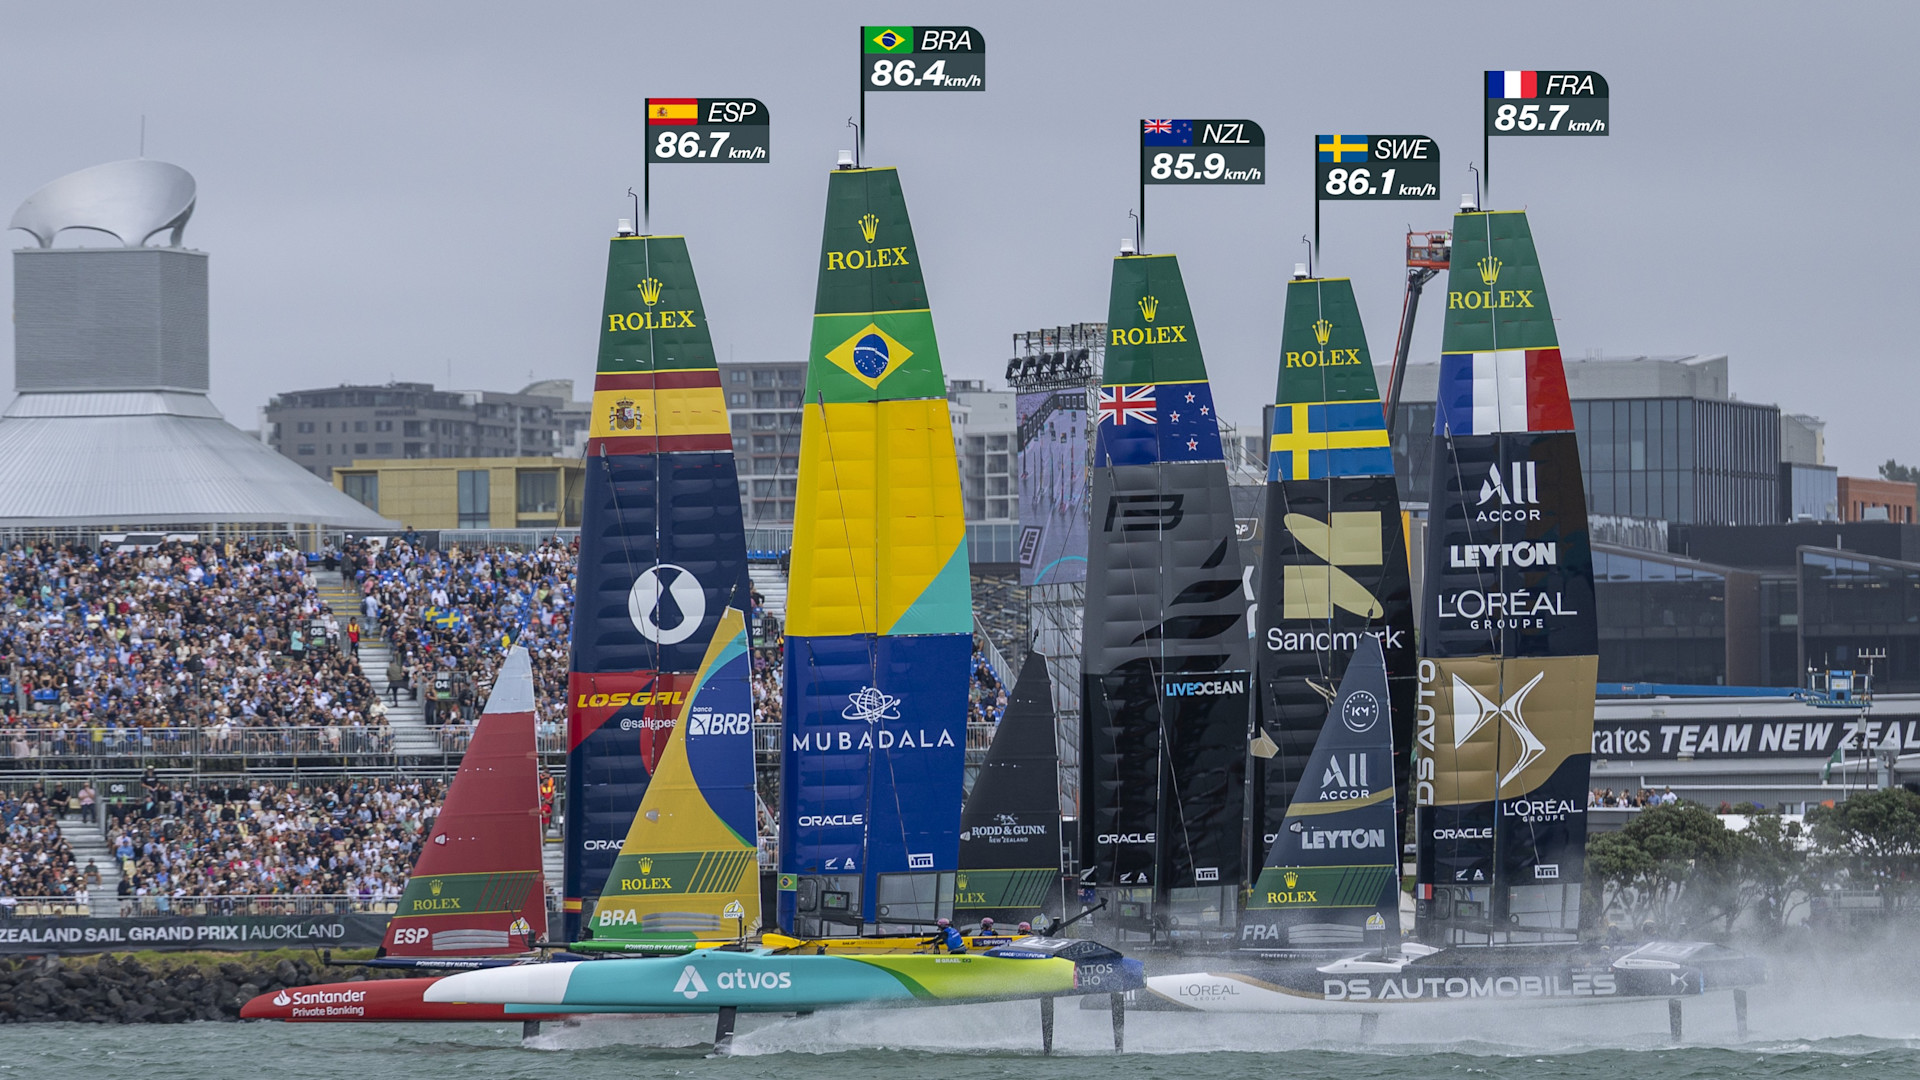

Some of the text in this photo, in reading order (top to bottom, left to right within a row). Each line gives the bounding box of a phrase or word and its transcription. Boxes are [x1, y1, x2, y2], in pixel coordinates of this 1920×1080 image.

[827, 246, 910, 270] ROLEX
[1448, 290, 1535, 311] ROLEX
[608, 310, 696, 332] ROLEX
[1111, 325, 1187, 346] ROLEX
[1286, 348, 1361, 369] ROLEX
[1476, 510, 1541, 522] ACCOR
[1450, 541, 1556, 568] LEYTON
[1438, 589, 1577, 619] L'ORÉAL
[1470, 618, 1544, 630] GROUPE
[710, 713, 750, 735] BRB
[1417, 659, 1436, 805] DS AUTO
[792, 728, 955, 752] MUBADALA
[1660, 724, 1753, 753] TEAM
[1758, 722, 1834, 751] NEW
[1320, 790, 1370, 800] ACCOR
[798, 814, 863, 827] ORACLE
[1522, 814, 1565, 822] GROUPE
[972, 825, 1046, 836] RODD & GUNN
[1097, 832, 1156, 845] ORACLE
[1301, 829, 1385, 849] LEYTON
[1433, 828, 1493, 840] ORACLE
[621, 878, 672, 891] ROLEX
[413, 898, 461, 911] ROLEX
[1267, 891, 1318, 904] ROLEX
[600, 909, 637, 926] BRA
[0, 923, 345, 943] ZEALAND SAIL GRAND PRIX AUCKLAND
[393, 928, 429, 945] ESP
[1242, 924, 1279, 941] FRA
[416, 960, 445, 968] POWERED
[717, 968, 792, 989] atvos
[1324, 974, 1617, 1001] DS AUTOMOBILES
[292, 989, 366, 1006] Santander
[292, 1005, 365, 1018] Private Banking
